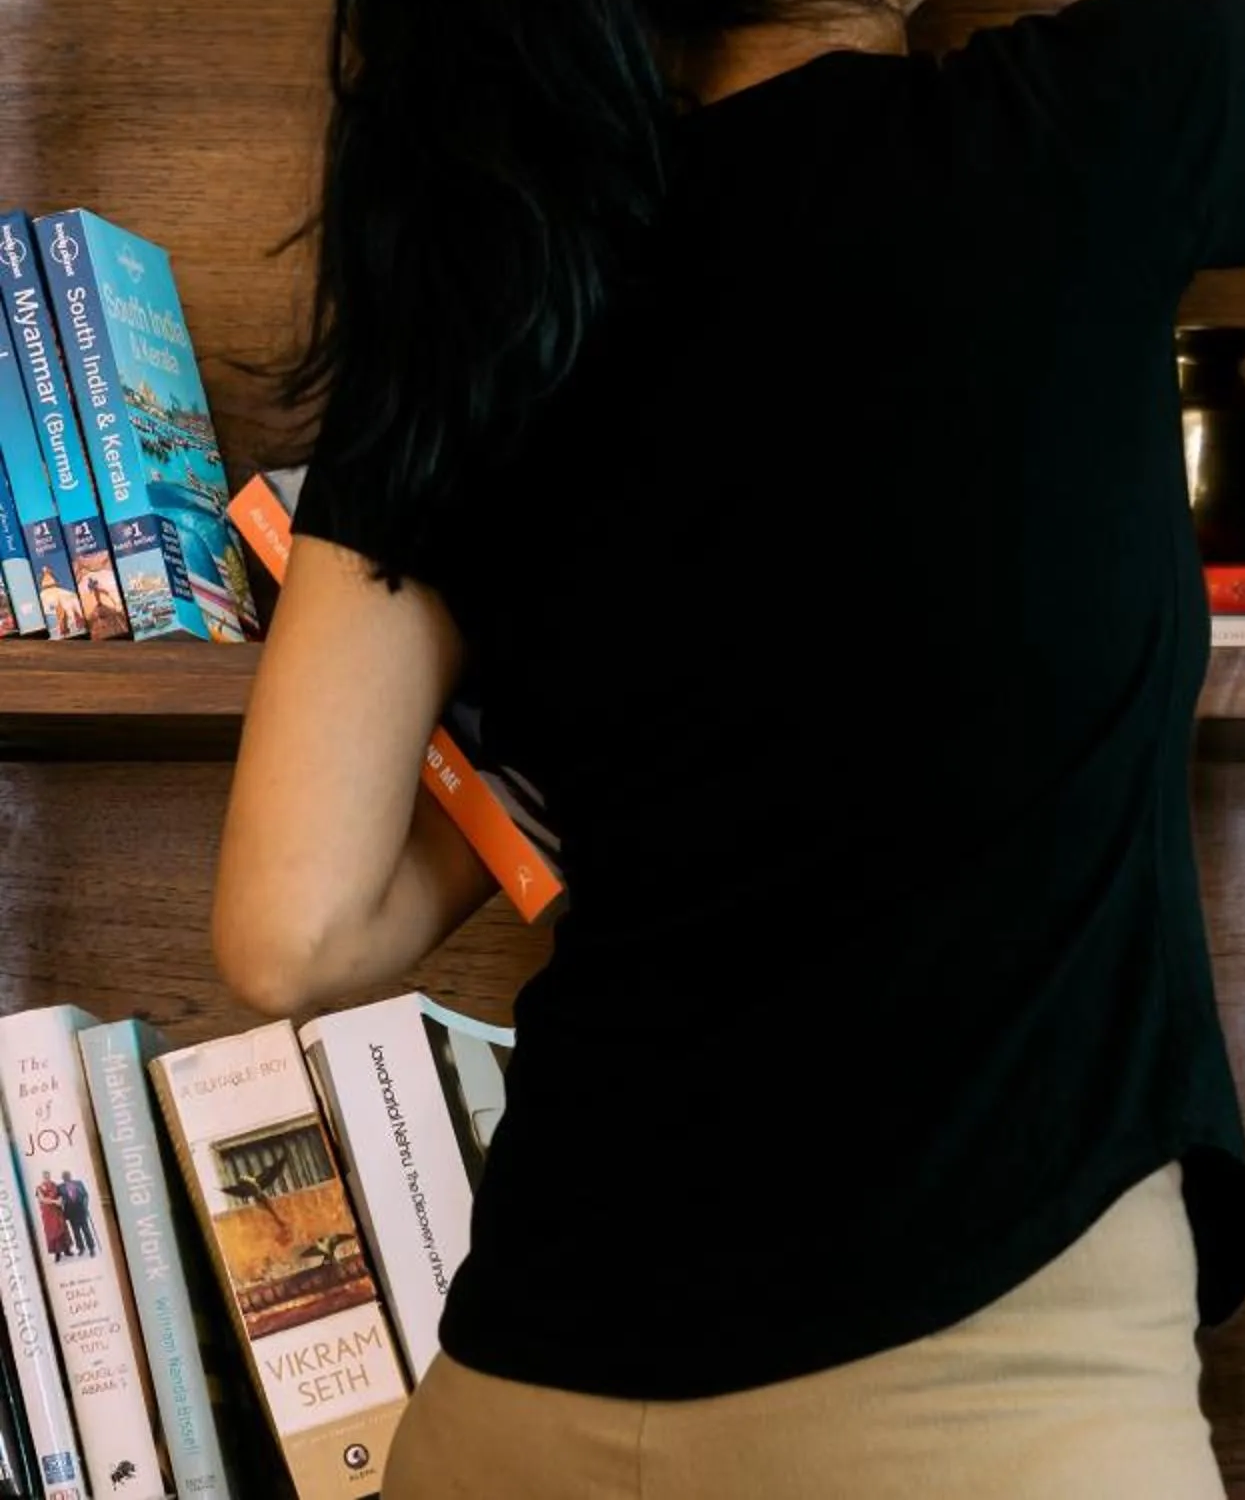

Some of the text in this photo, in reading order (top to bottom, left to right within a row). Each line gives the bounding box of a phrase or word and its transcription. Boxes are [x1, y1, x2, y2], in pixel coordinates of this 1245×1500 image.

[13, 288, 79, 493] Myanmar (Burma)
[66, 287, 130, 502] South India & Kerala
[124, 523, 142, 536] #1
[439, 765, 462, 794] ME
[17, 1057, 50, 1074] The
[18, 1077, 60, 1098] Book
[369, 1043, 400, 1128] Jawaharlal
[24, 1124, 79, 1157] JOY
[392, 1121, 414, 1168] Nehru
[101, 1052, 171, 1283] Making India Work
[407, 1170, 420, 1193] The
[412, 1193, 435, 1250] Discovery
[265, 1326, 384, 1381] VIKRAM
[297, 1363, 370, 1408] SETH
